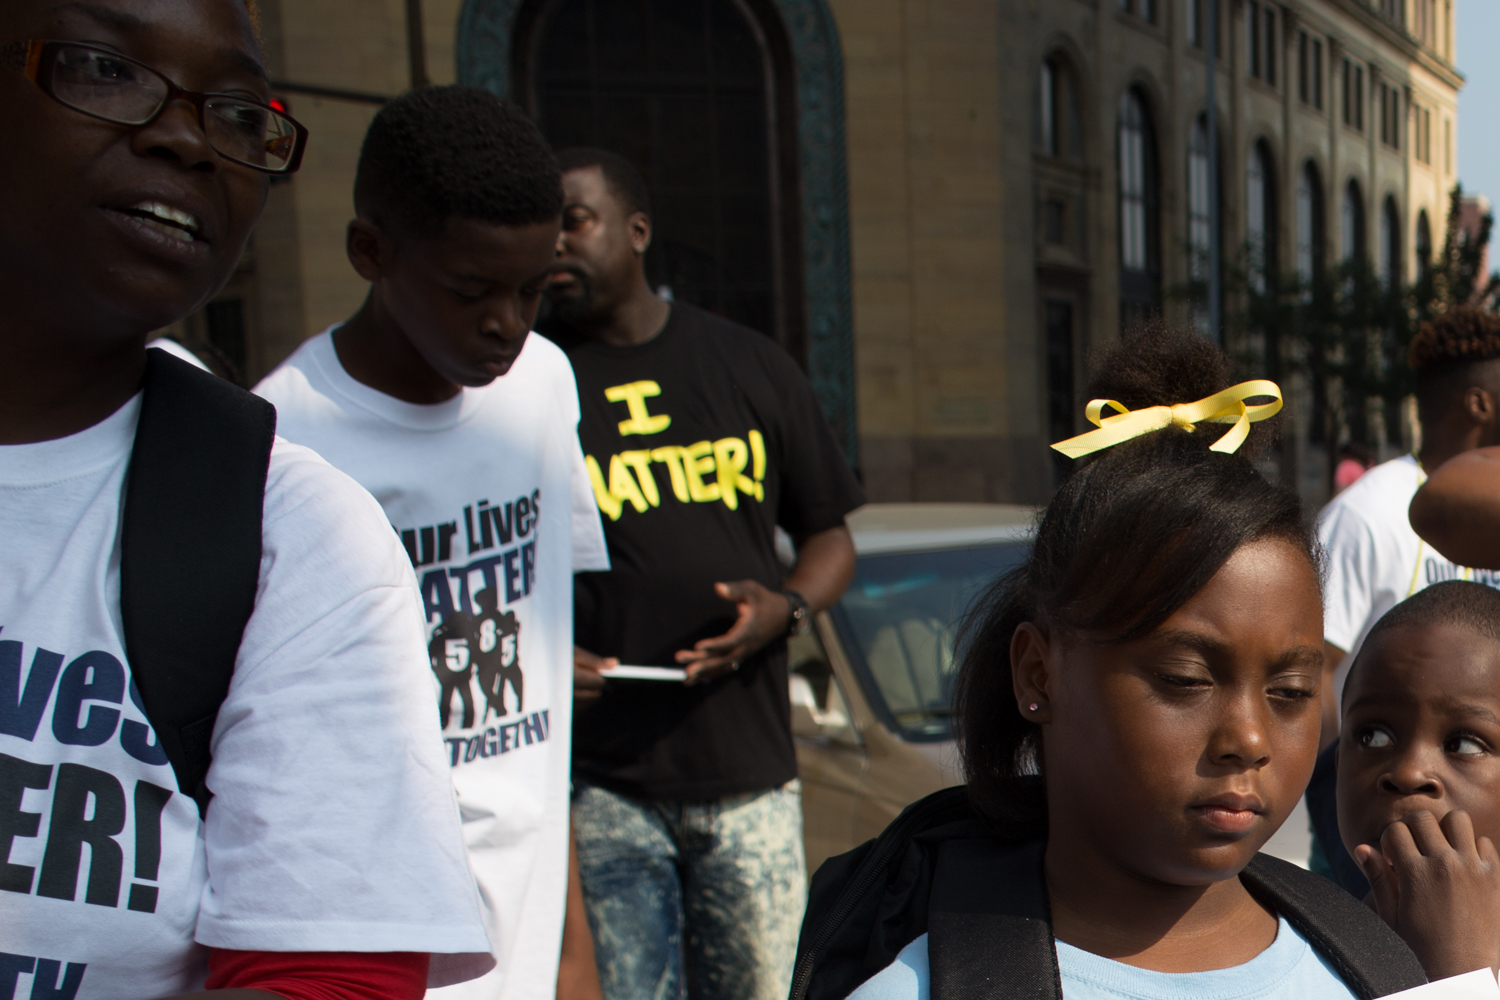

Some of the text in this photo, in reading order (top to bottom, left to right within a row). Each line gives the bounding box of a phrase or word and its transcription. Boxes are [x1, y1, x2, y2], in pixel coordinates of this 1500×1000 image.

[604, 380, 671, 436] I
[390, 487, 541, 569] ur Lives
[442, 709, 550, 768] TOGETH
